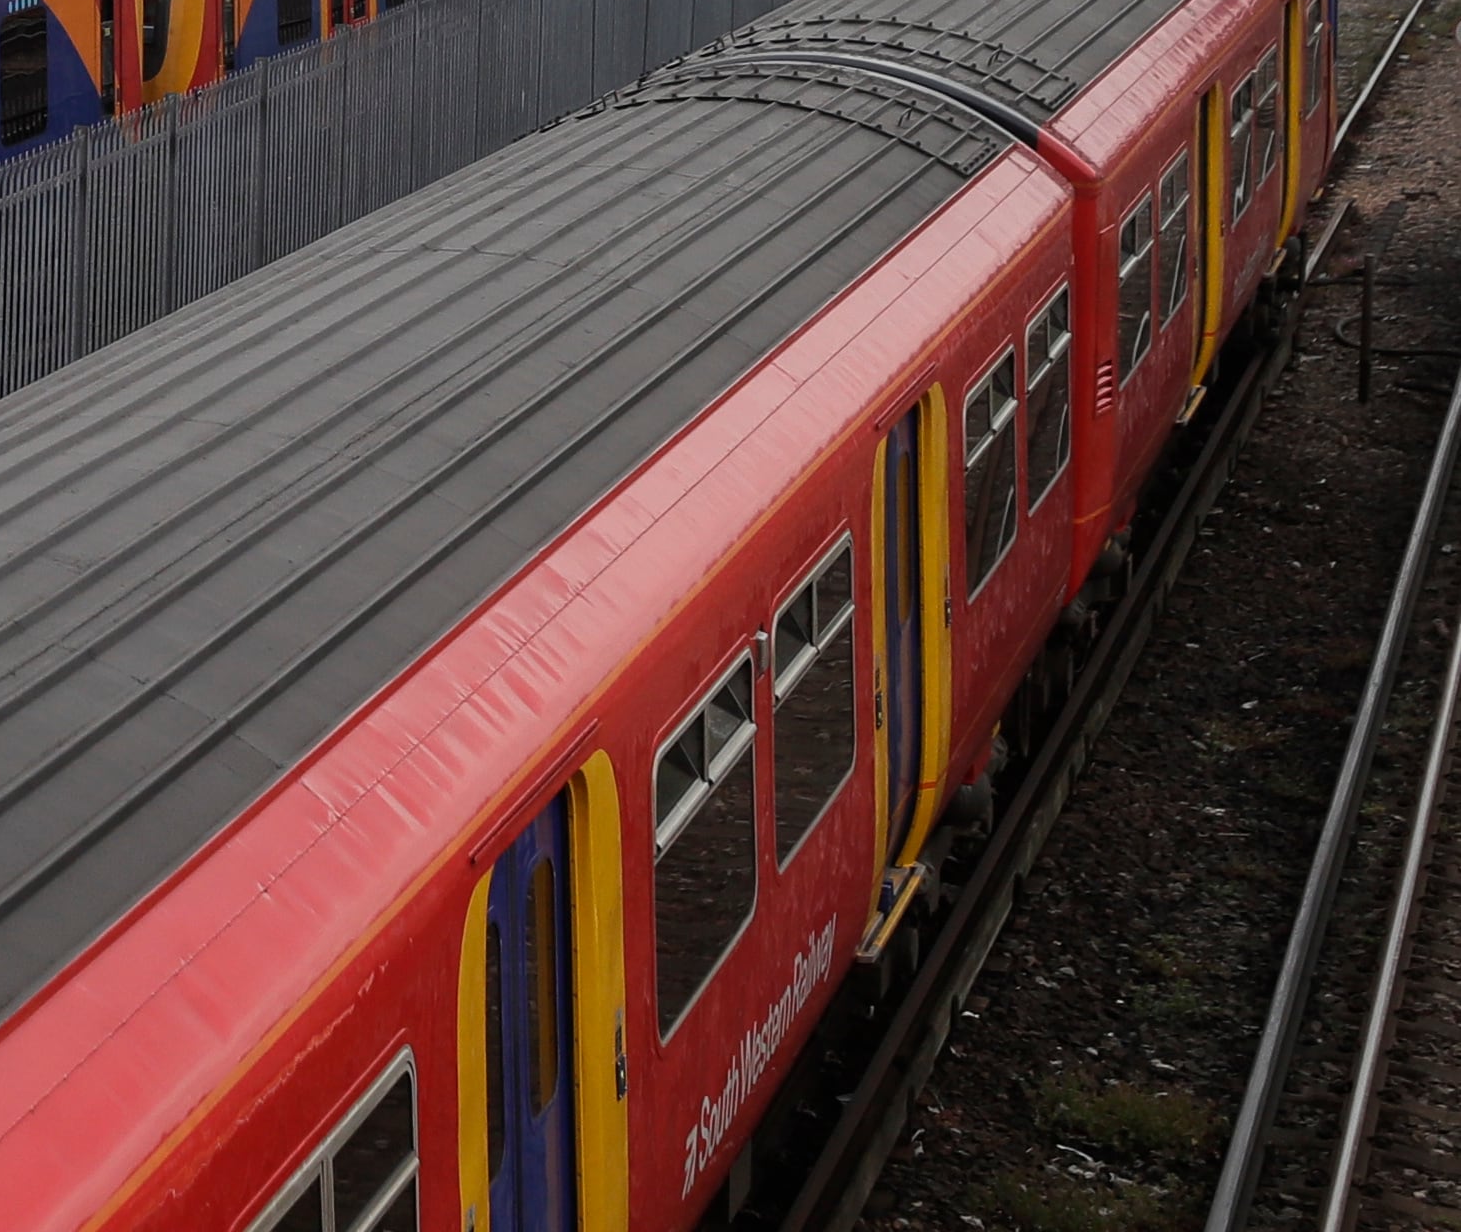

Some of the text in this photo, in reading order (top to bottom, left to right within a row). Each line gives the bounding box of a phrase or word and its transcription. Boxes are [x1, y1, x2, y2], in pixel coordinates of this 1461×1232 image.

[698, 911, 837, 1173] South Western Railway
